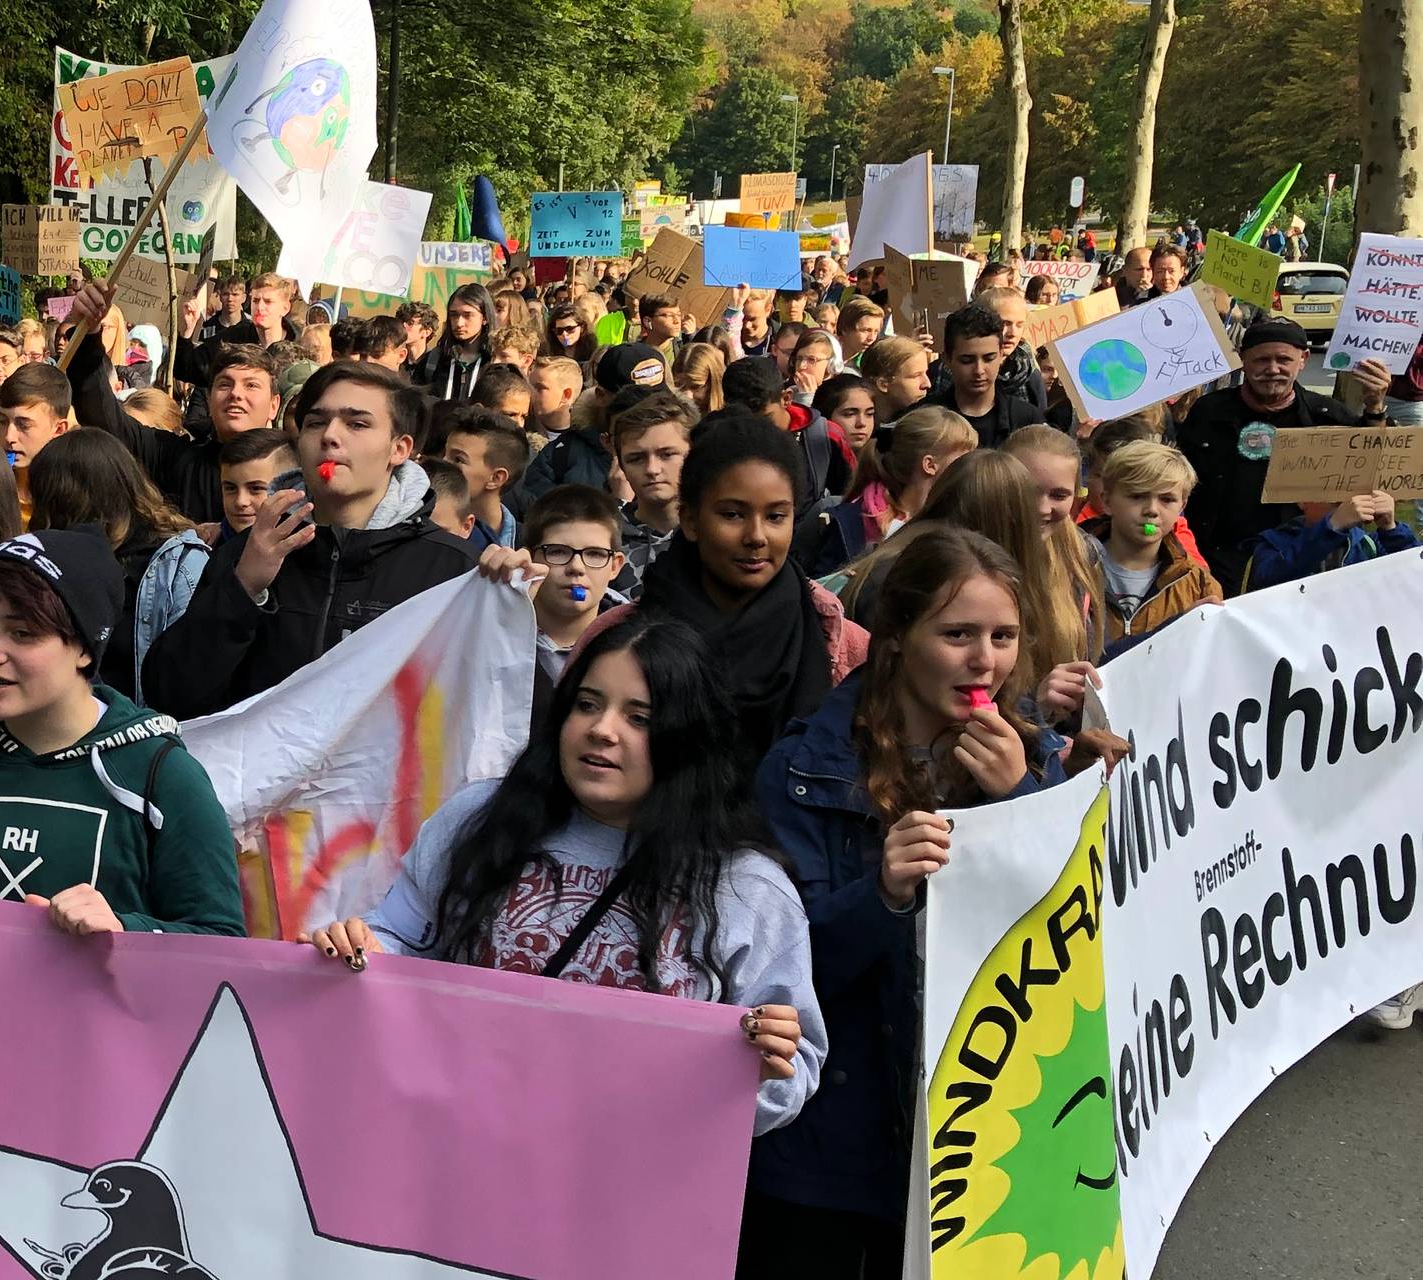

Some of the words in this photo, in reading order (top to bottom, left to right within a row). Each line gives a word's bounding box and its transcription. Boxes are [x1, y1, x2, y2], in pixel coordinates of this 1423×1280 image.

[70, 83, 114, 112] WE
[79, 118, 132, 148] HAVE
[148, 112, 162, 134] A
[4, 208, 26, 226] ICH
[36, 208, 63, 222] WILL
[534, 200, 545, 211] ES
[549, 195, 563, 208] IST
[602, 210, 613, 218] 12
[537, 231, 559, 239] ZEIT
[421, 243, 491, 266] UNSERE
[1214, 236, 1248, 262] There
[39, 257, 78, 272] STRASSE
[1343, 334, 1414, 356] MACHEN!
[1177, 351, 1224, 376] Tack
[1306, 433, 1343, 448] THE
[1349, 433, 1415, 449] CHANGE
[1282, 455, 1333, 471] WANT
[1343, 455, 1368, 469] TO
[1320, 474, 1360, 491] THE
[2, 826, 39, 853] RH
[1194, 829, 1262, 902] Brennstoff-
[1111, 981, 1195, 1178] eine
[1200, 832, 1423, 1041] Rechnu
[930, 822, 1107, 1253] WINDKRA
